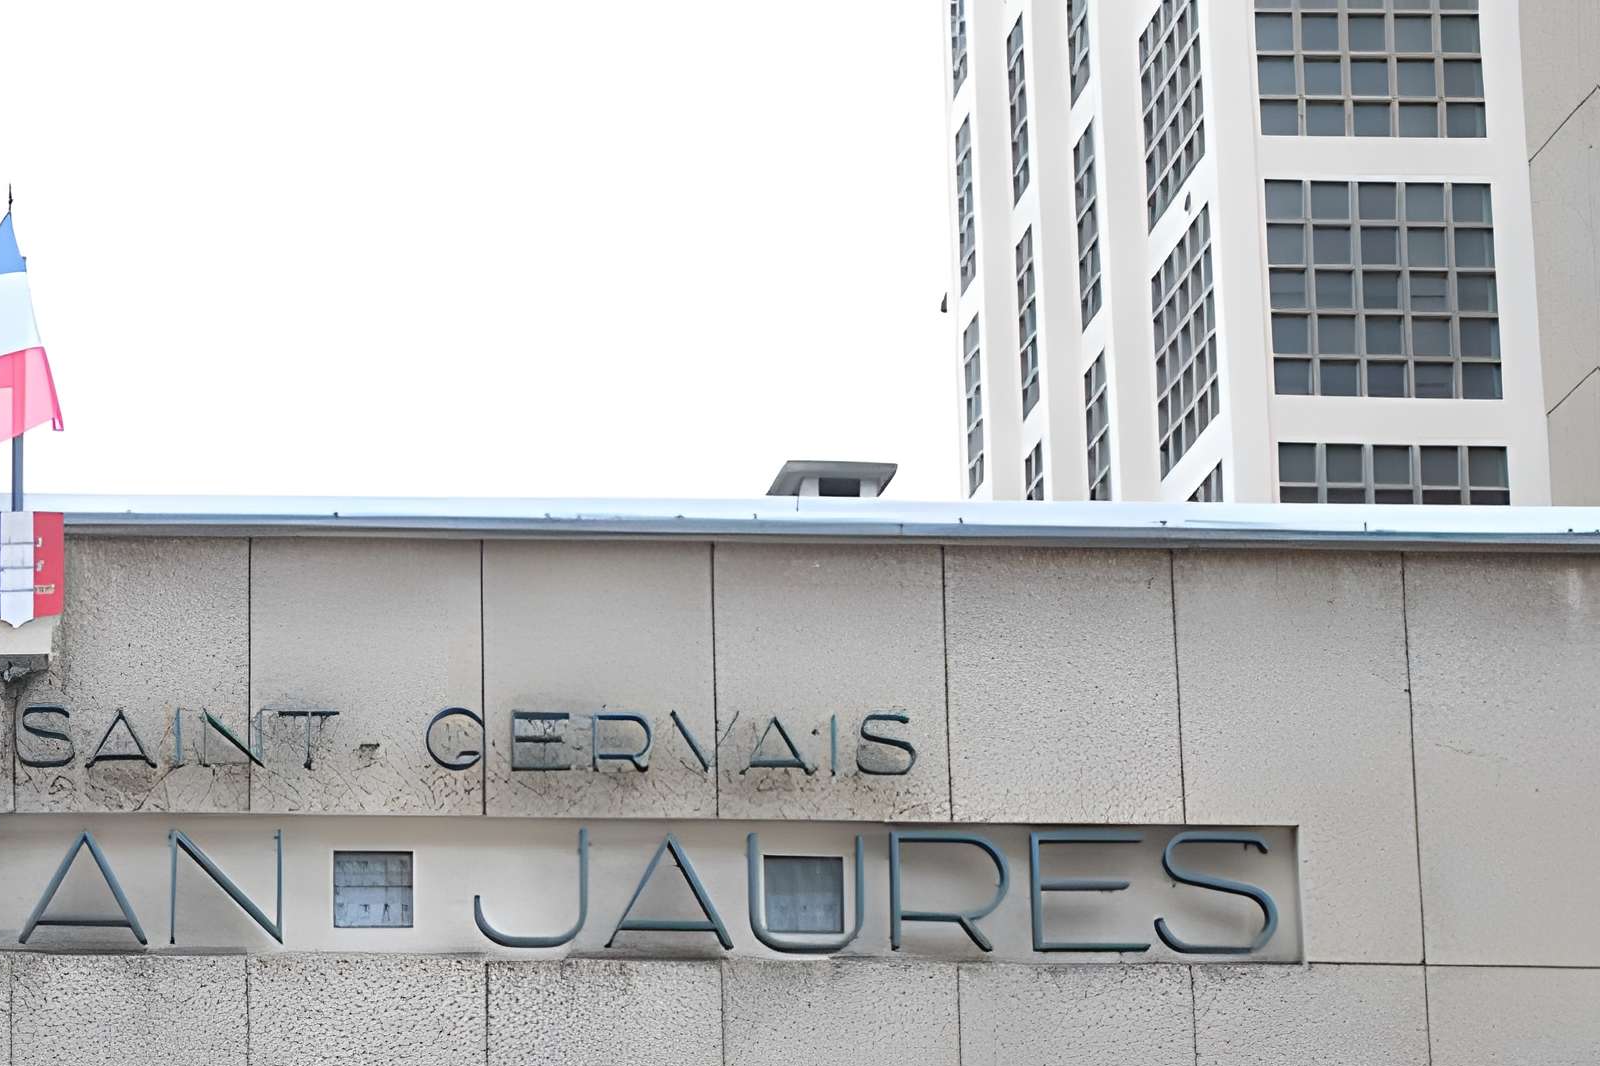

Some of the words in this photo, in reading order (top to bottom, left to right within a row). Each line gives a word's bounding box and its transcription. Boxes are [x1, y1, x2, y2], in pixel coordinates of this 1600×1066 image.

[16, 701, 340, 770] SAINT
[425, 706, 918, 776] GERVAIS
[474, 826, 1277, 954] JAURES
